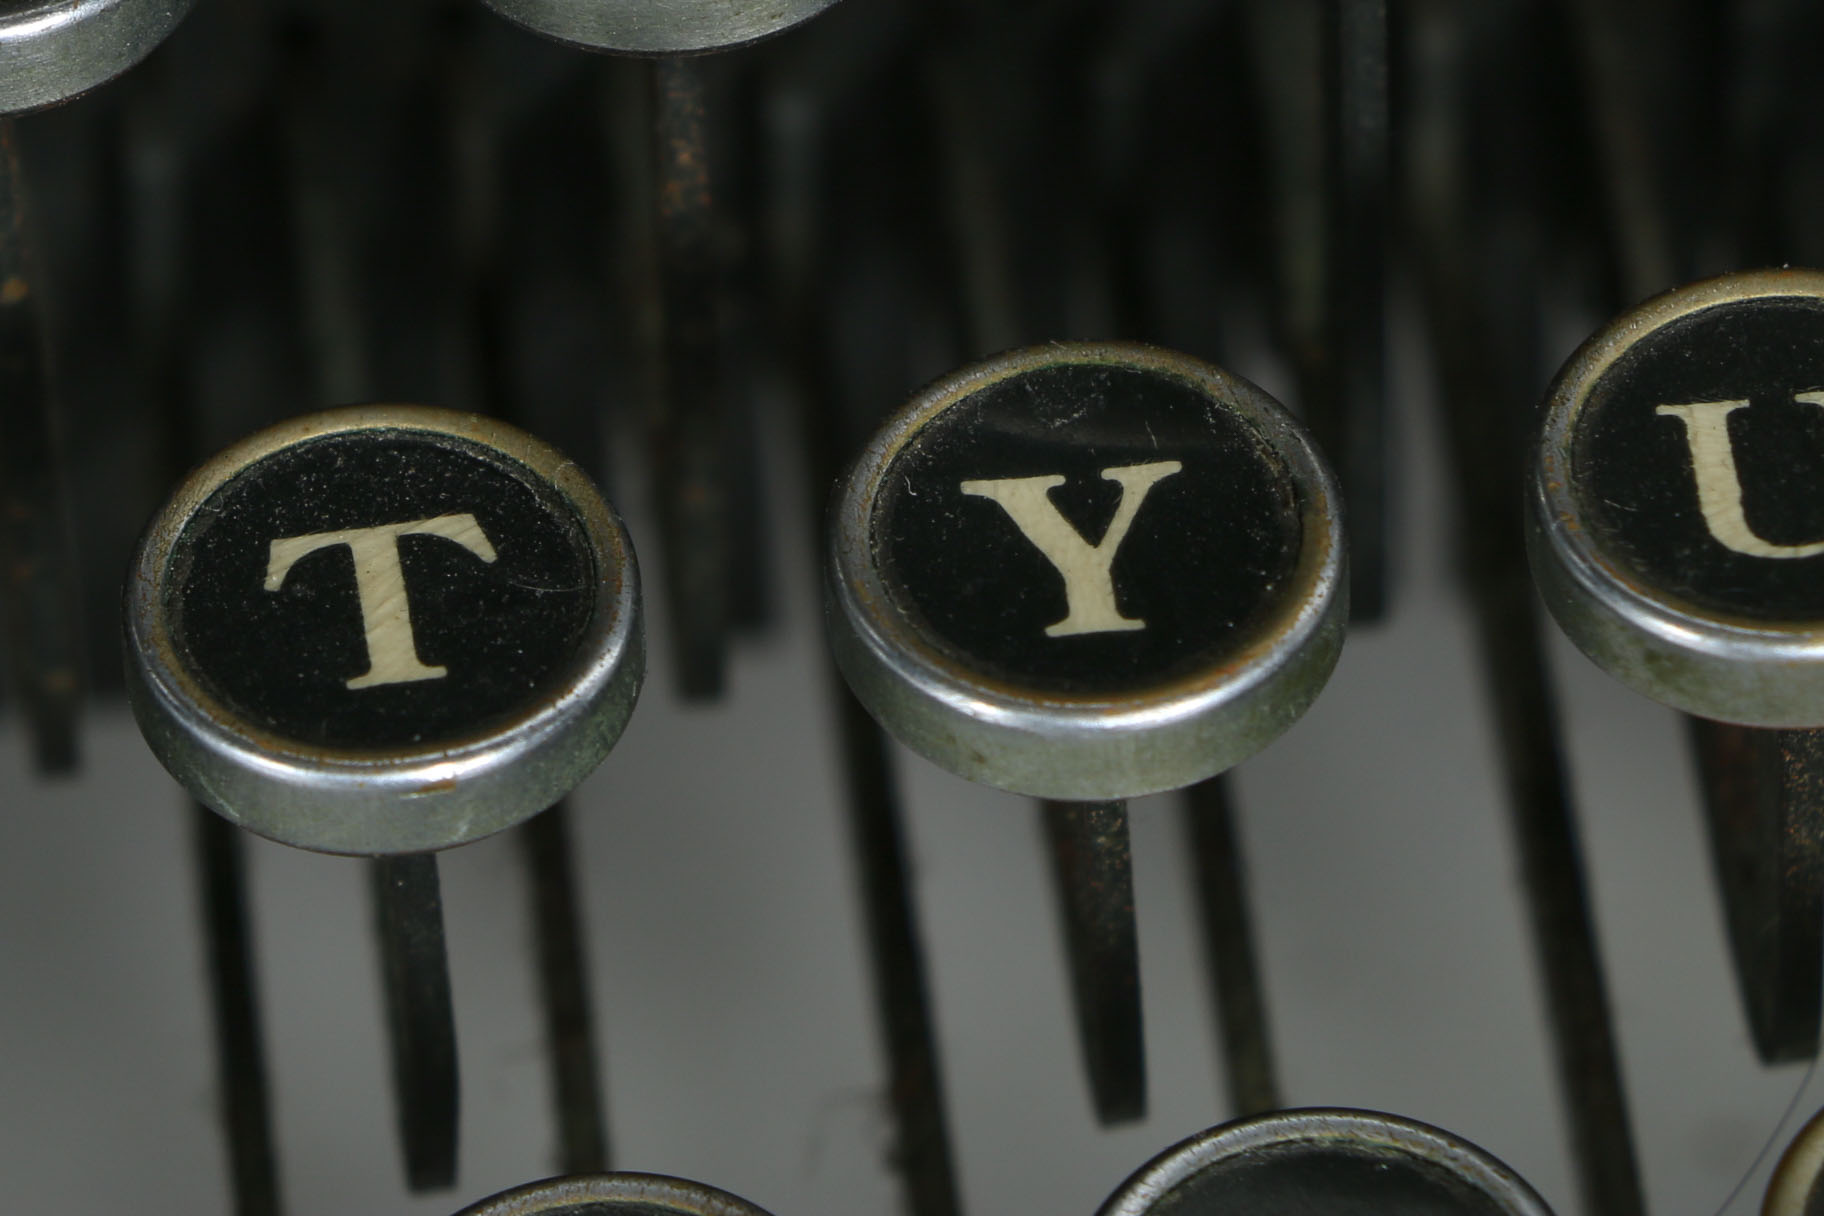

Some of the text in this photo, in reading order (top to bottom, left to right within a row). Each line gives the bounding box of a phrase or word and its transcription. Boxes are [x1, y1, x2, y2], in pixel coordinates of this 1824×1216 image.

[960, 460, 1183, 637] Y
[1656, 390, 1824, 559] U
[263, 513, 497, 690] T
